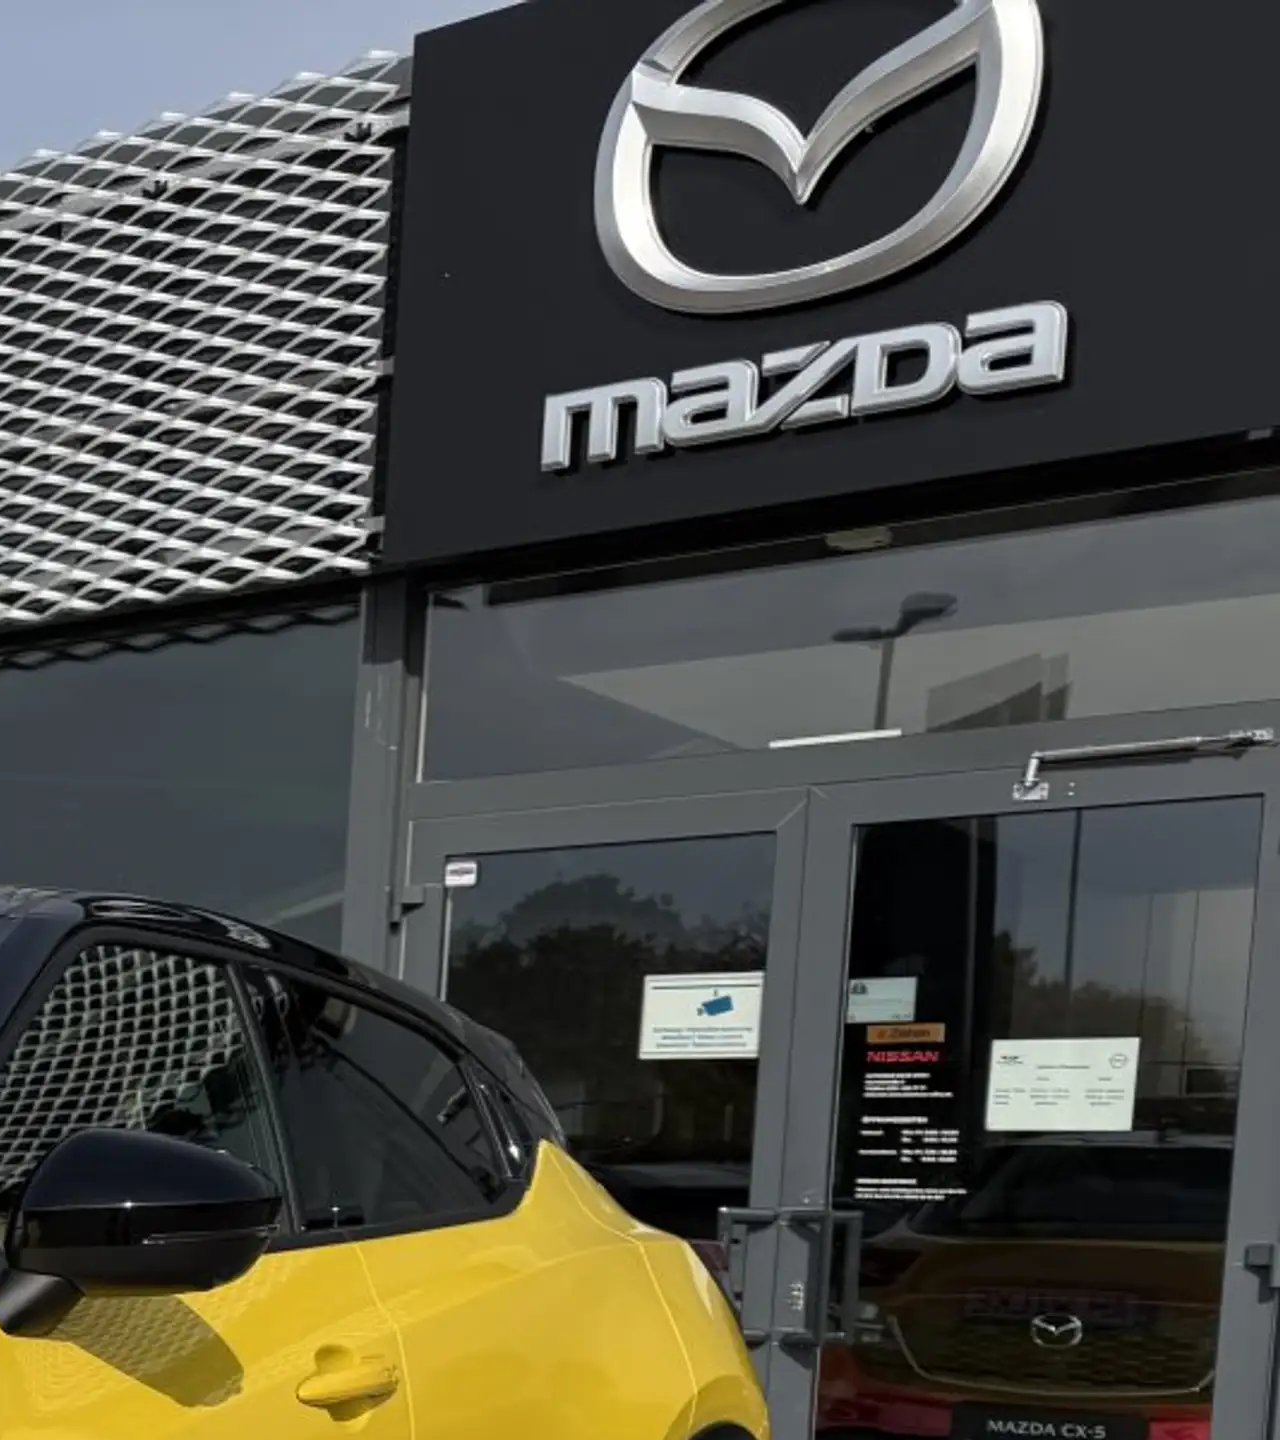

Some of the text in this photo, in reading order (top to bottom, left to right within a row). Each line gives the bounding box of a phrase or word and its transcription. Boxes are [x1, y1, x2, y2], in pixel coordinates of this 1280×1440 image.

[867, 1050, 939, 1062] NISSAN
[987, 1420, 1107, 1440] MAZDA CX-5
